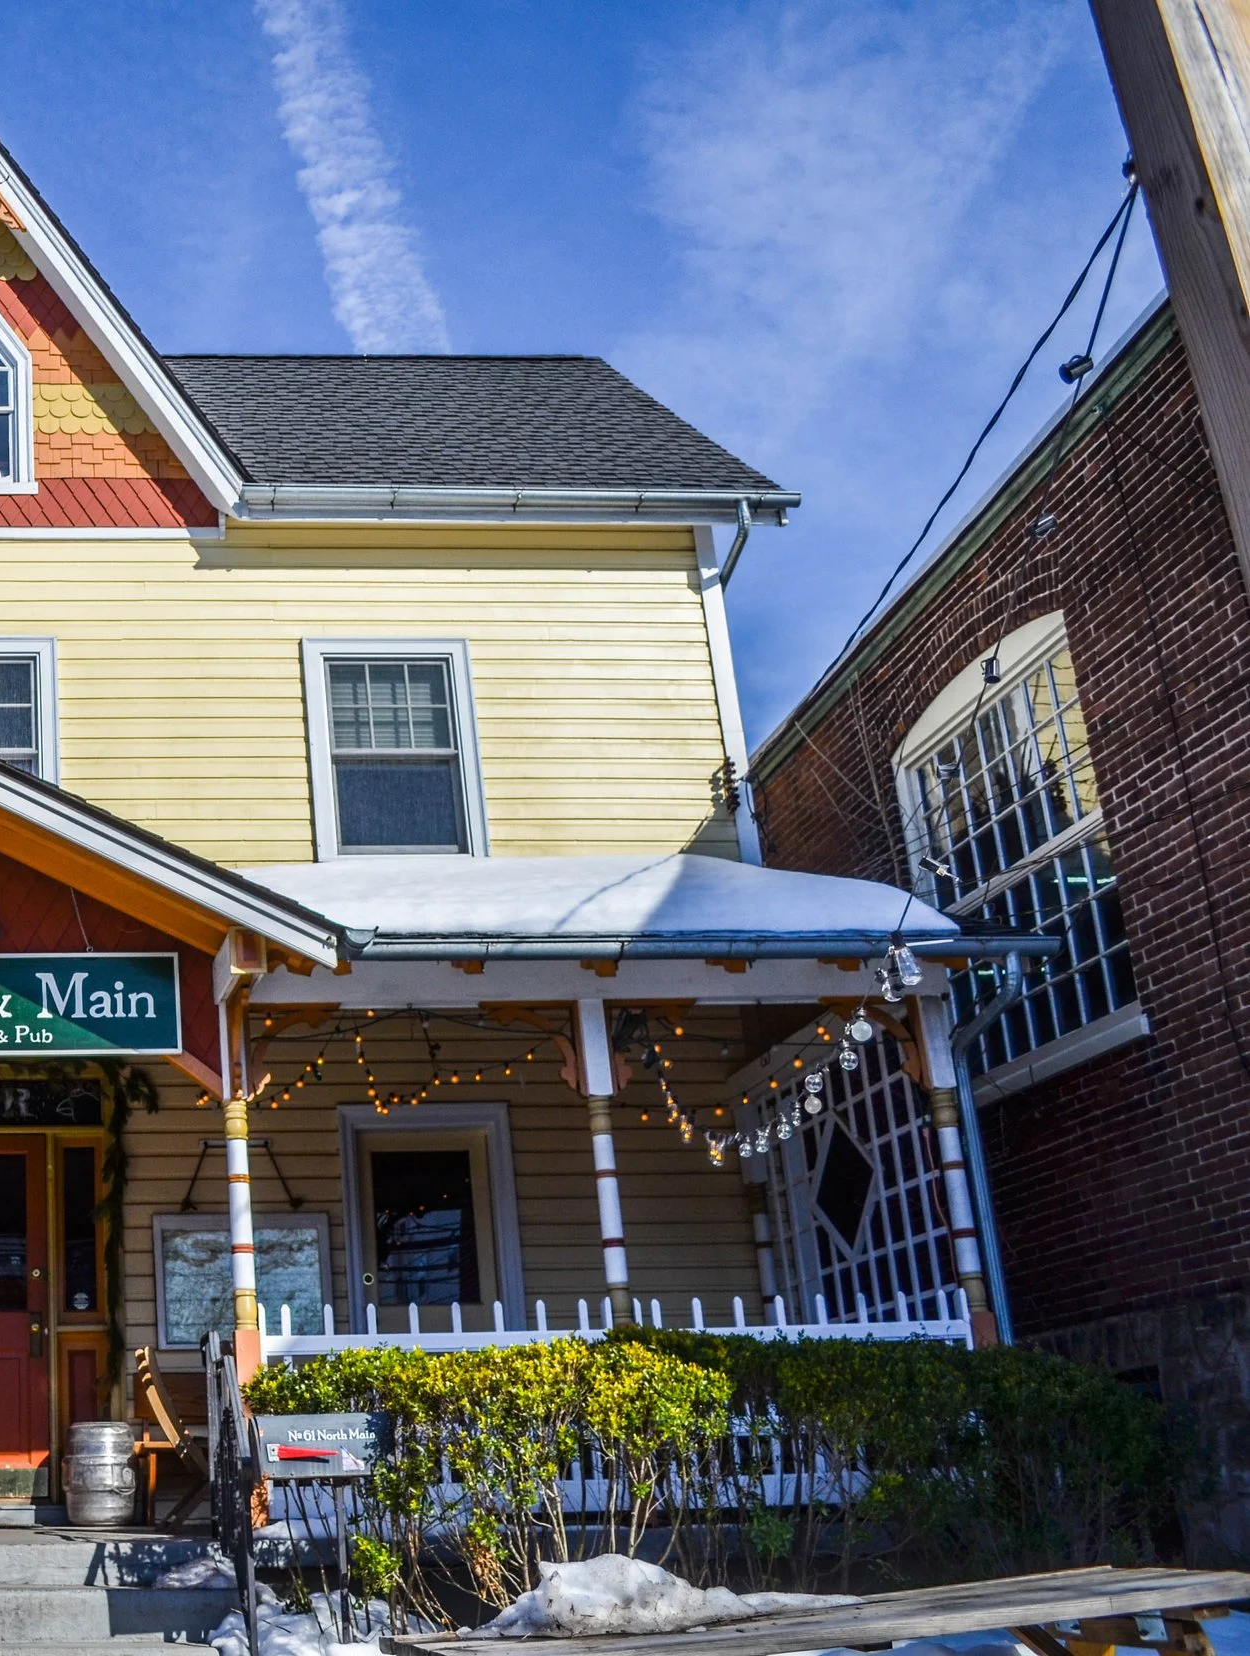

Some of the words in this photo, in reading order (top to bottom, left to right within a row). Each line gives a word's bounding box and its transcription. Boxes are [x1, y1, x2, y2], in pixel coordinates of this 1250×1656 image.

[35, 972, 157, 1019] Main
[14, 1025, 54, 1044] Pub
[303, 1429, 316, 1441] 61
[317, 1428, 347, 1441] North
[348, 1427, 376, 1440] Main
